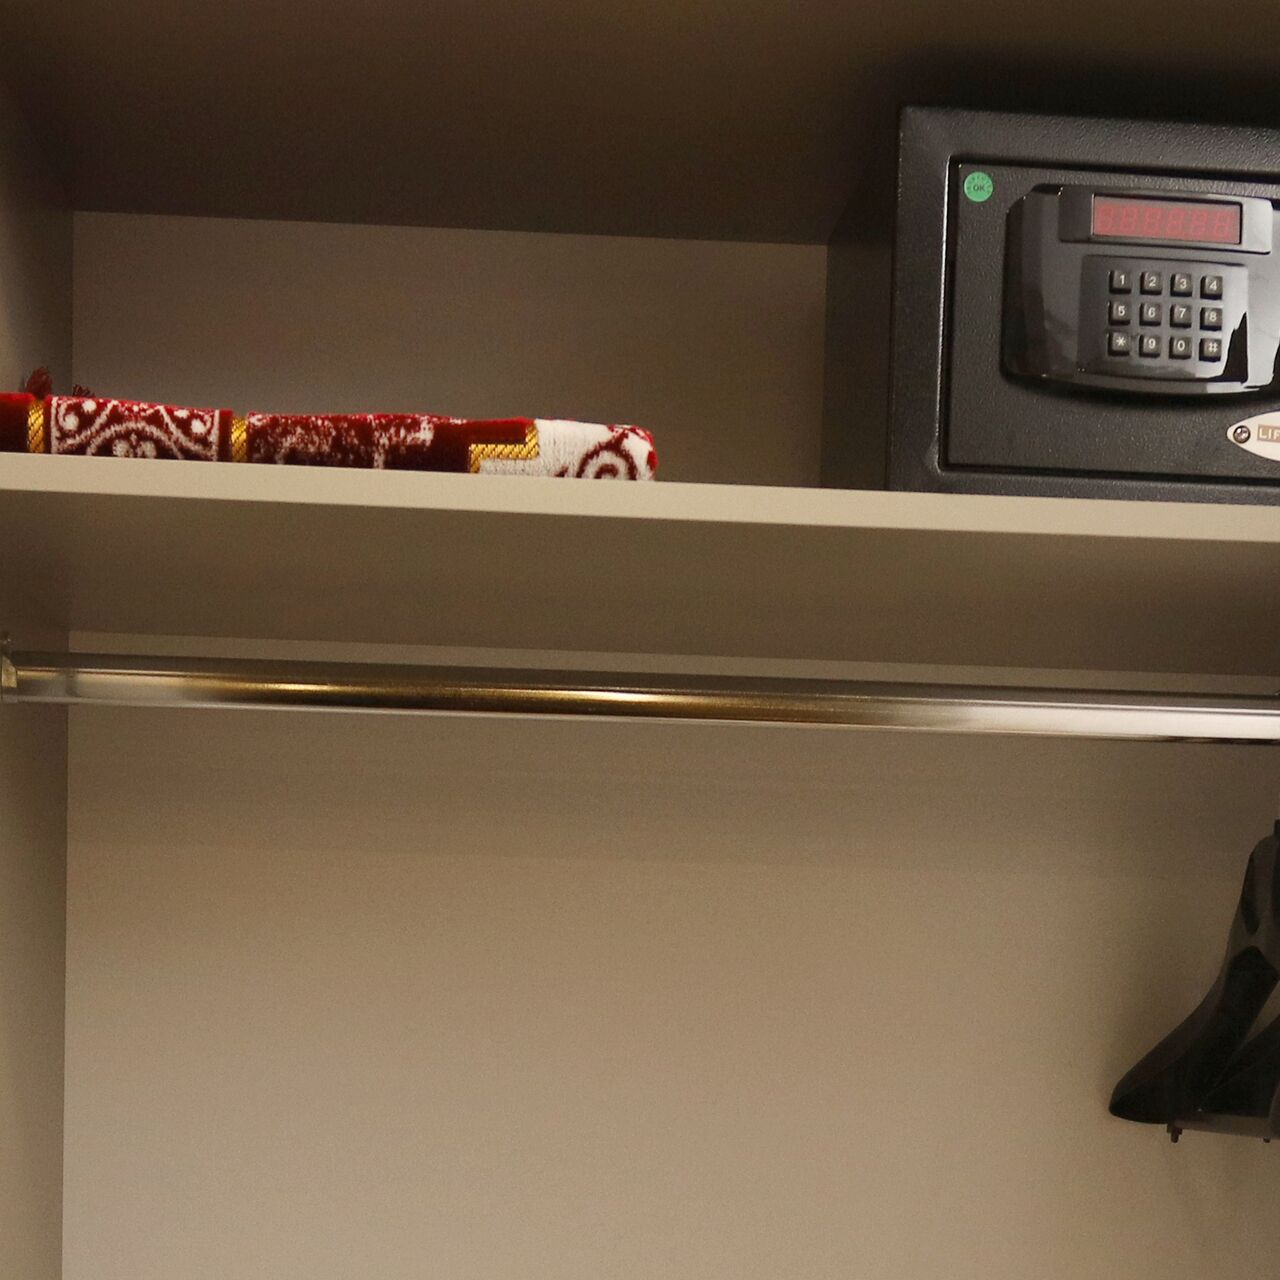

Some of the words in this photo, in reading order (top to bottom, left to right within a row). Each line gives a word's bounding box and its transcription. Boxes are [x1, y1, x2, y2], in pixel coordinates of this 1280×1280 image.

[973, 183, 986, 193] OK
[1120, 274, 1125, 285] 1
[1149, 276, 1157, 287] 2
[1179, 278, 1187, 289] 3
[1209, 280, 1218, 291] 4
[1118, 305, 1126, 316] 5
[1148, 307, 1156, 318] 6
[1179, 308, 1187, 319] 7
[1209, 311, 1217, 322] 8
[1148, 338, 1156, 349] 9
[1177, 340, 1186, 351] 0
